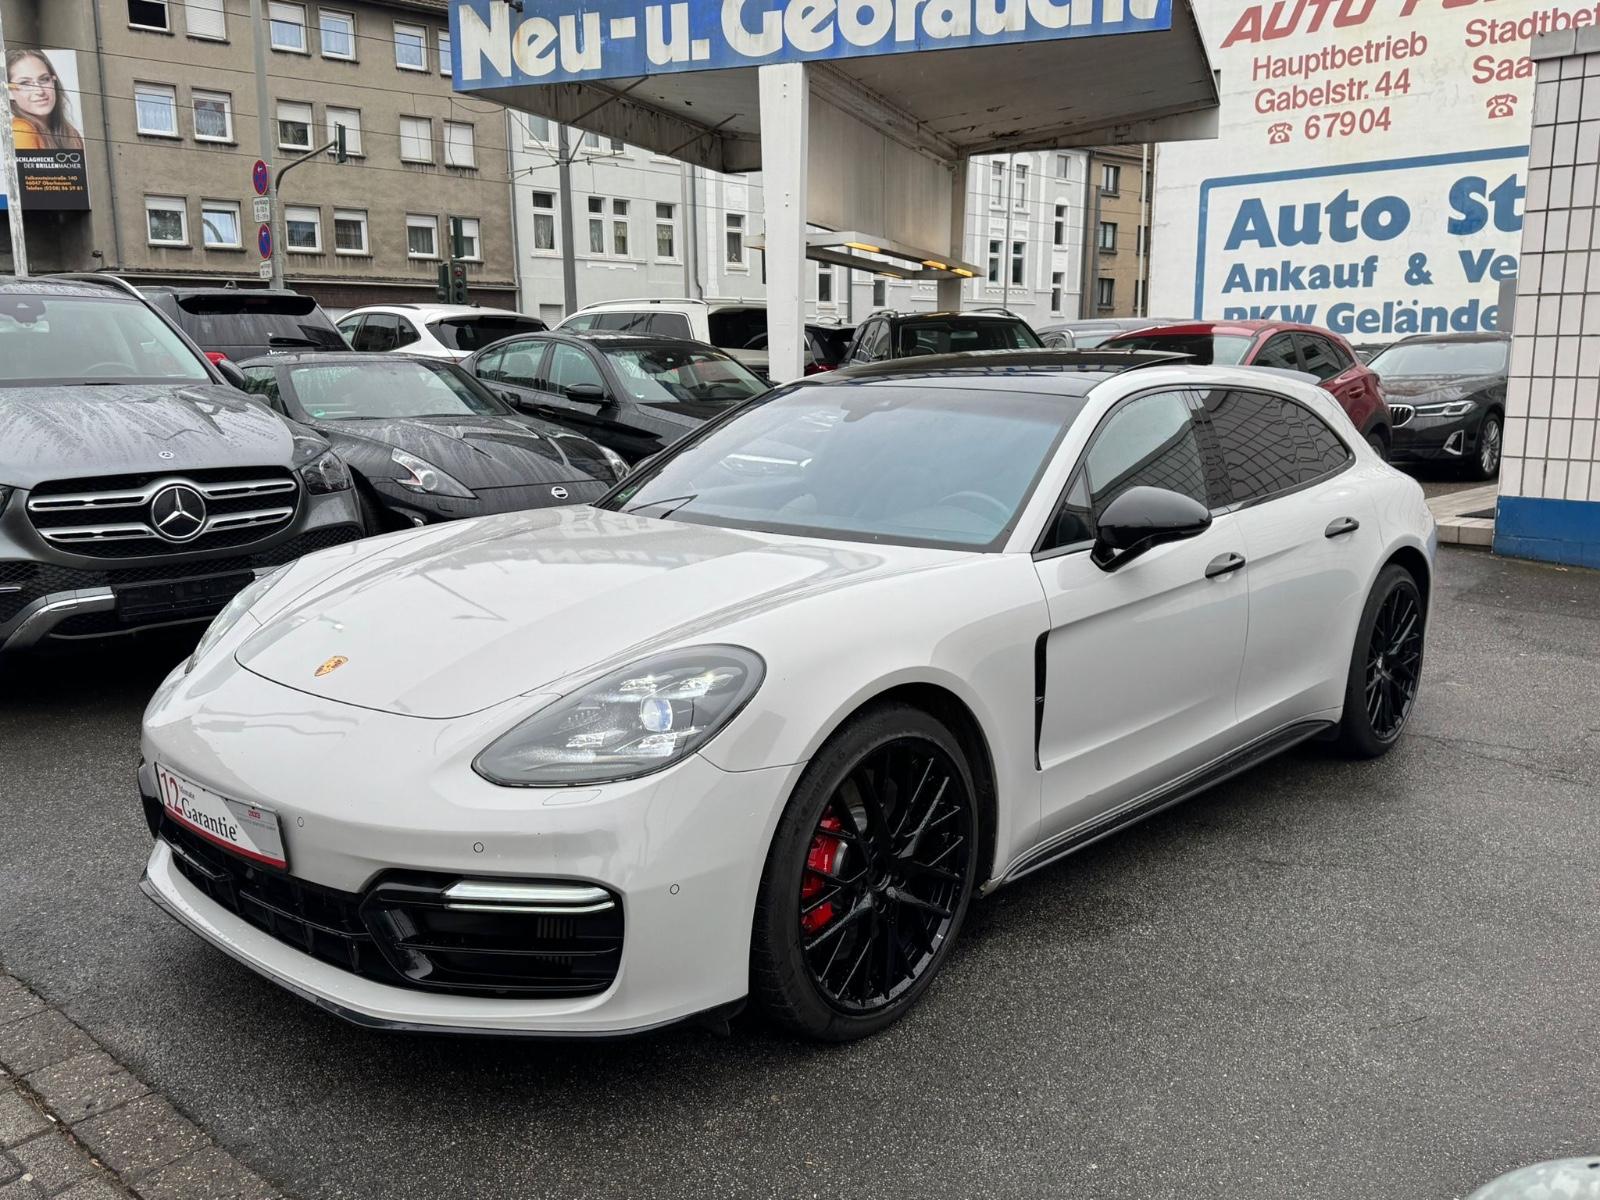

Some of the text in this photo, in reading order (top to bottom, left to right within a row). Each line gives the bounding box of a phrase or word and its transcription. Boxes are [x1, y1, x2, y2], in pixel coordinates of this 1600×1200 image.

[1252, 31, 1428, 81] Hauptbetrieb
[1254, 68, 1411, 114] Gabelstr. 44
[1304, 106, 1392, 140] 67904
[1223, 173, 1526, 251] Auto St
[1221, 255, 1379, 294] Ankauf
[1404, 251, 1434, 286] &
[160, 772, 183, 817] 12
[181, 797, 238, 842] Garantie
